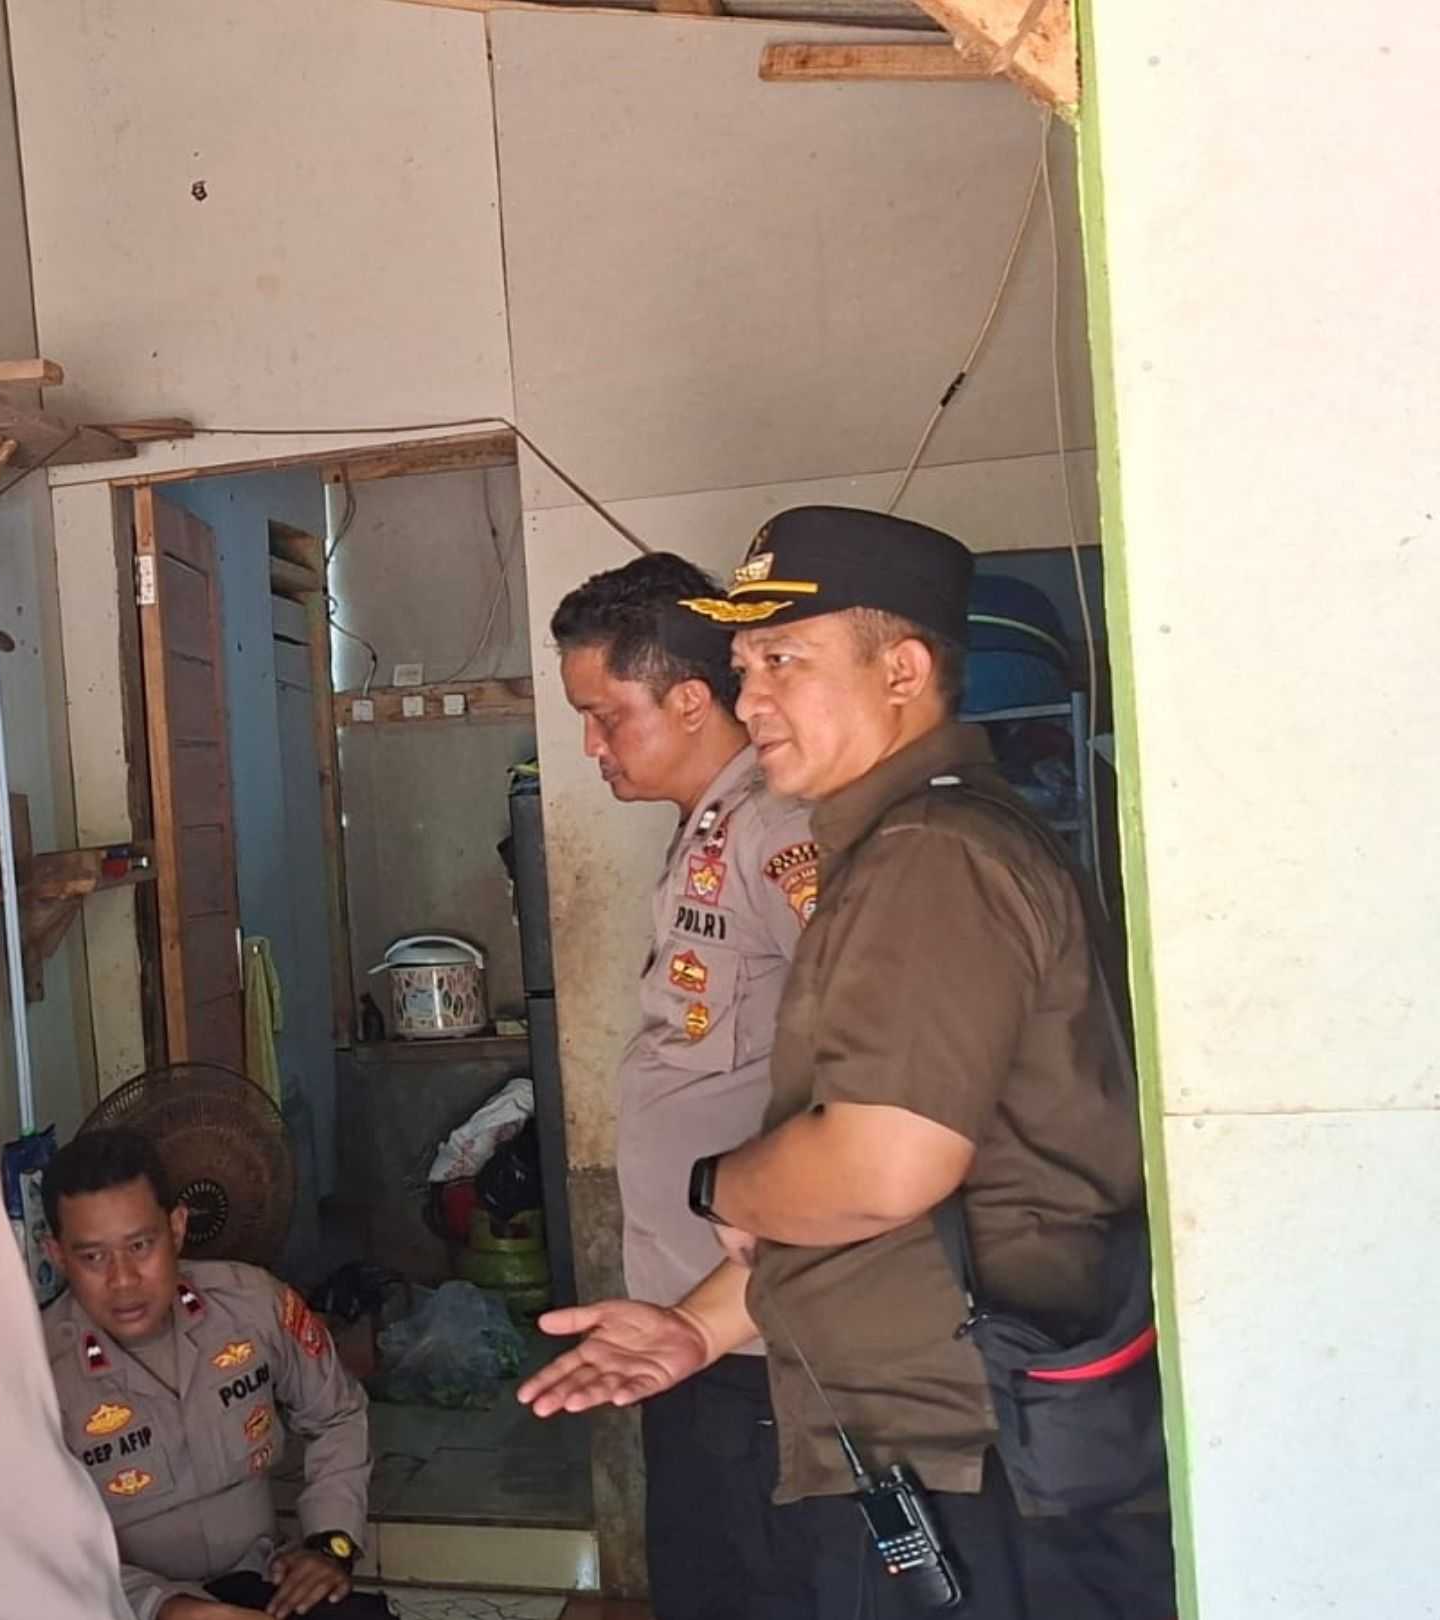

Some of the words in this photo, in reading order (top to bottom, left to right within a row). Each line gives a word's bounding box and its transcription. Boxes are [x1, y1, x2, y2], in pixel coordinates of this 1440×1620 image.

[675, 906, 726, 939] POLRI
[219, 1362, 270, 1408] POLRI
[83, 1443, 112, 1466] CEP
[119, 1426, 152, 1456] AFIP
